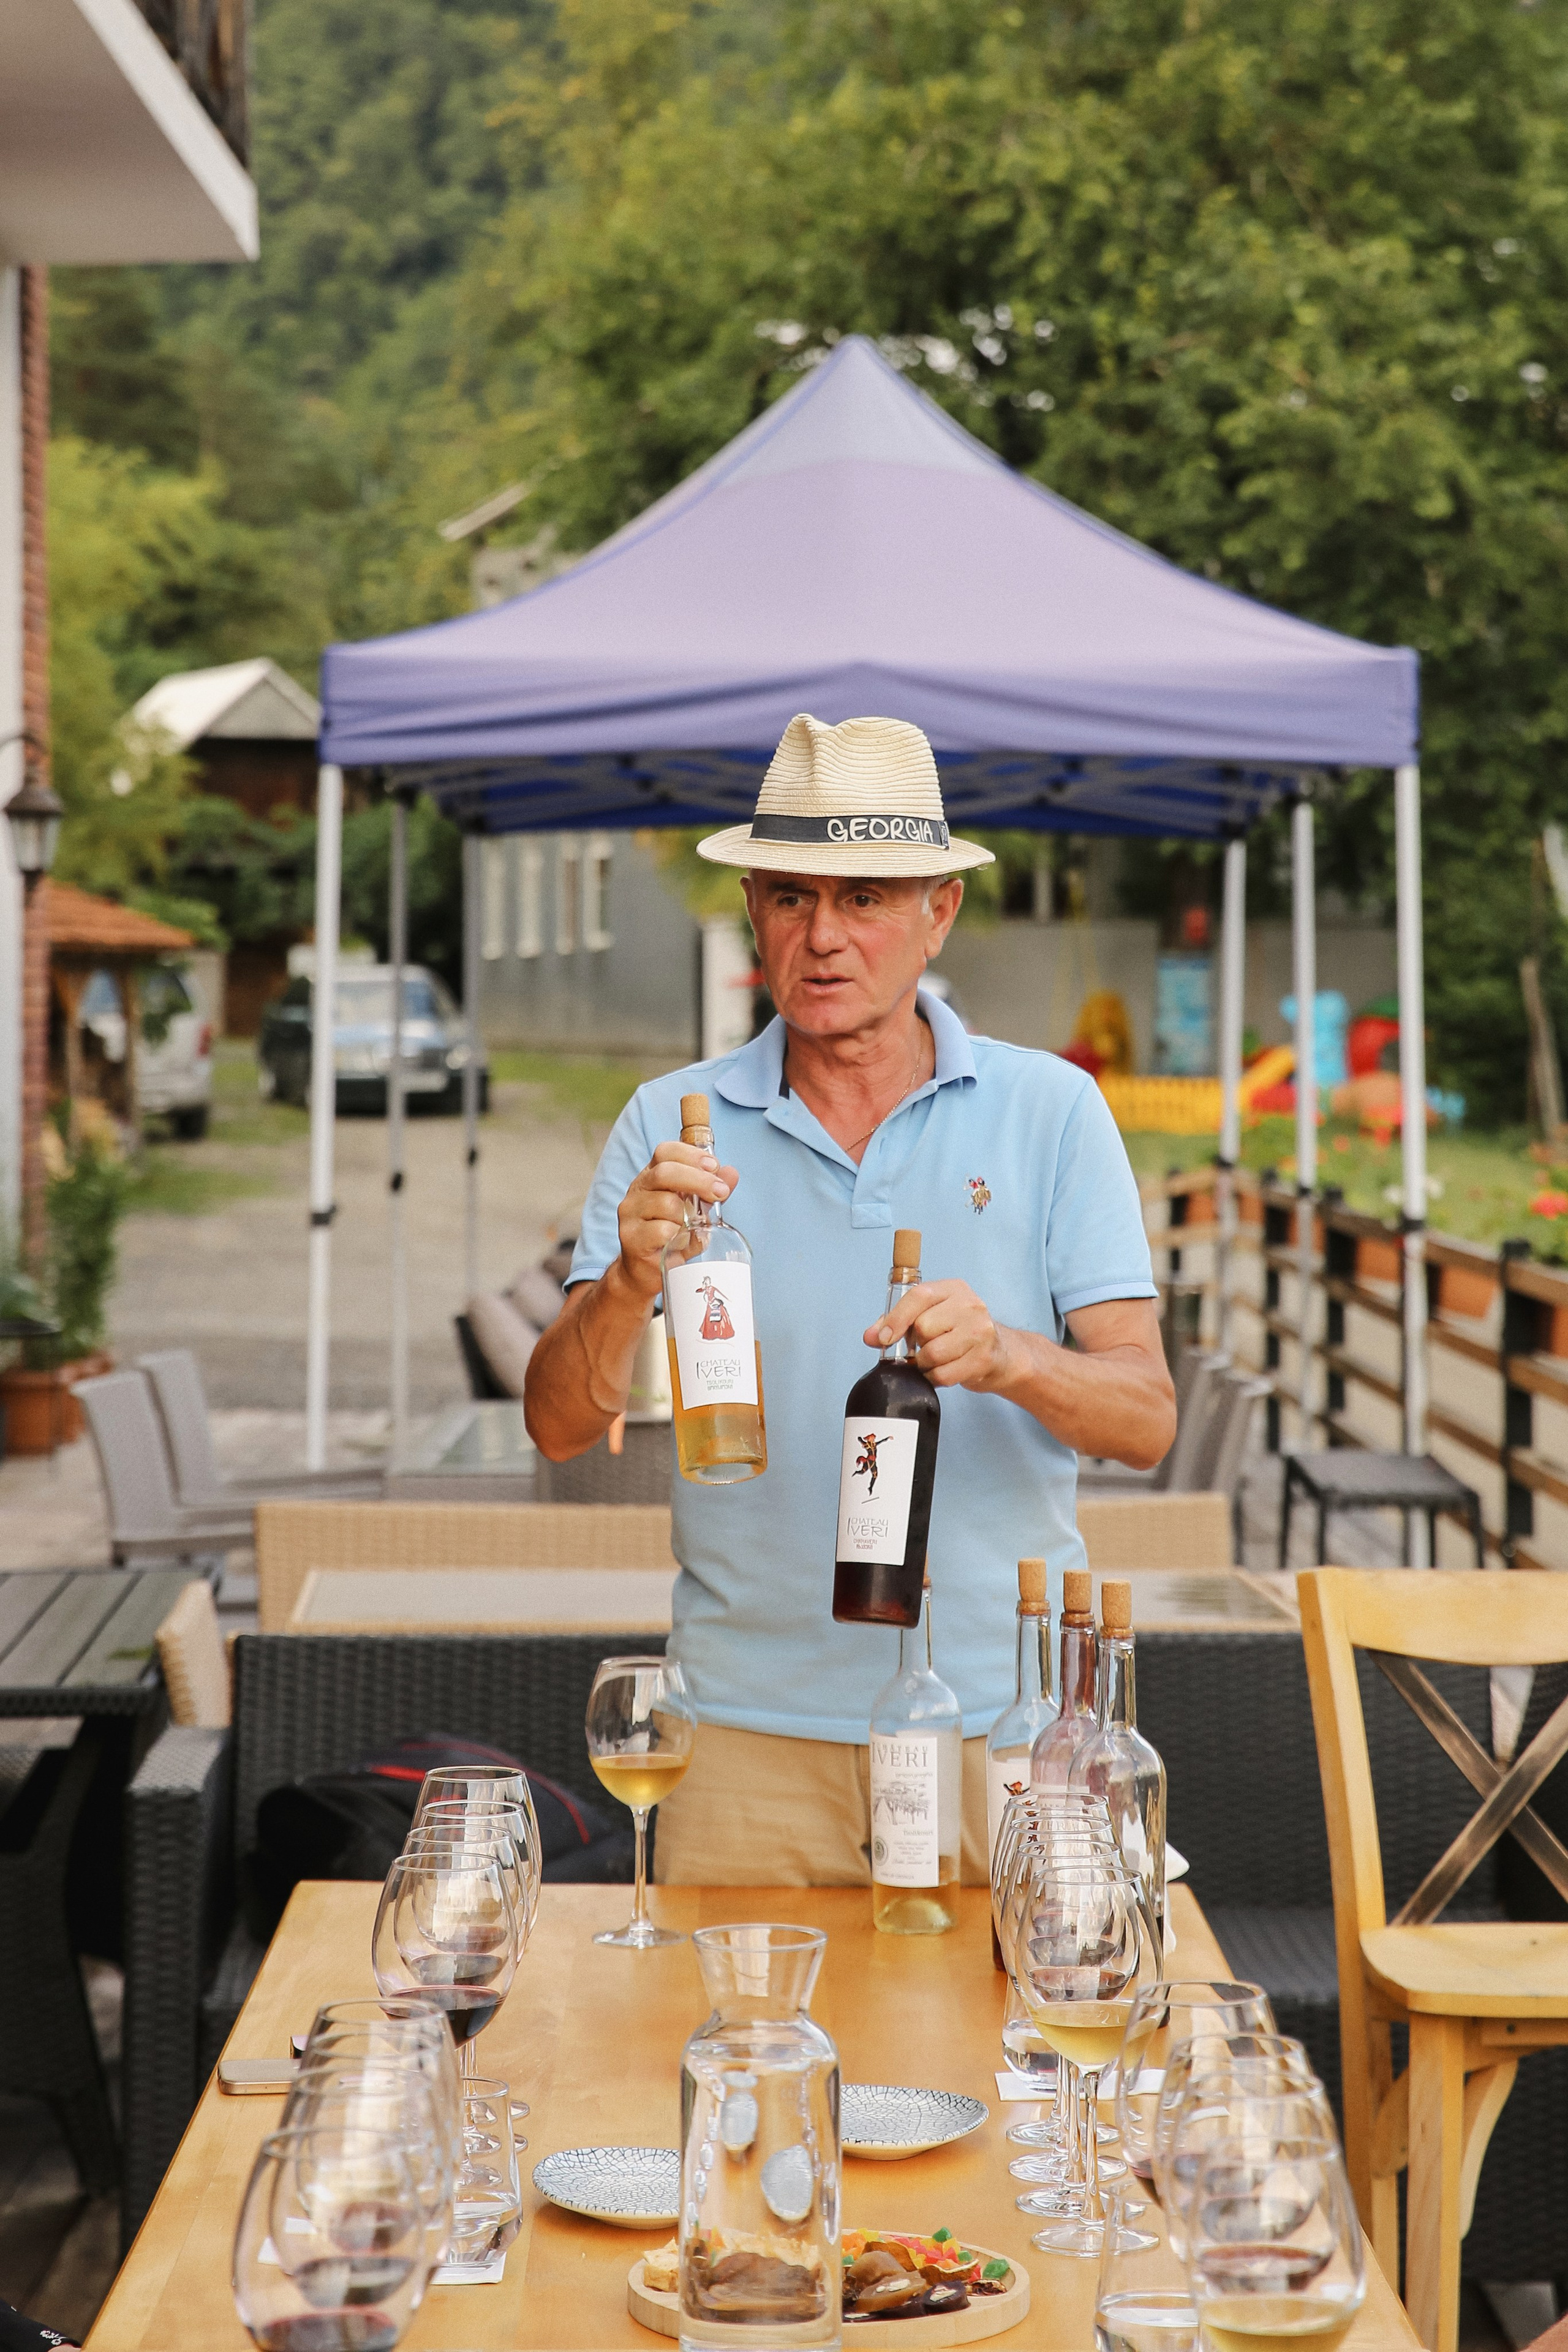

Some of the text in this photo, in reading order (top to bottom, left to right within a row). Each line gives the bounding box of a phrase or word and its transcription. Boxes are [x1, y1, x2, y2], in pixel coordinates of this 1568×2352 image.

[827, 818, 933, 842] GEORGIA
[696, 1362, 741, 1379] IVERI
[701, 1359, 741, 1368] CHATEAU
[847, 1518, 888, 1537] IVERI
[872, 1742, 928, 1767] IVERI
